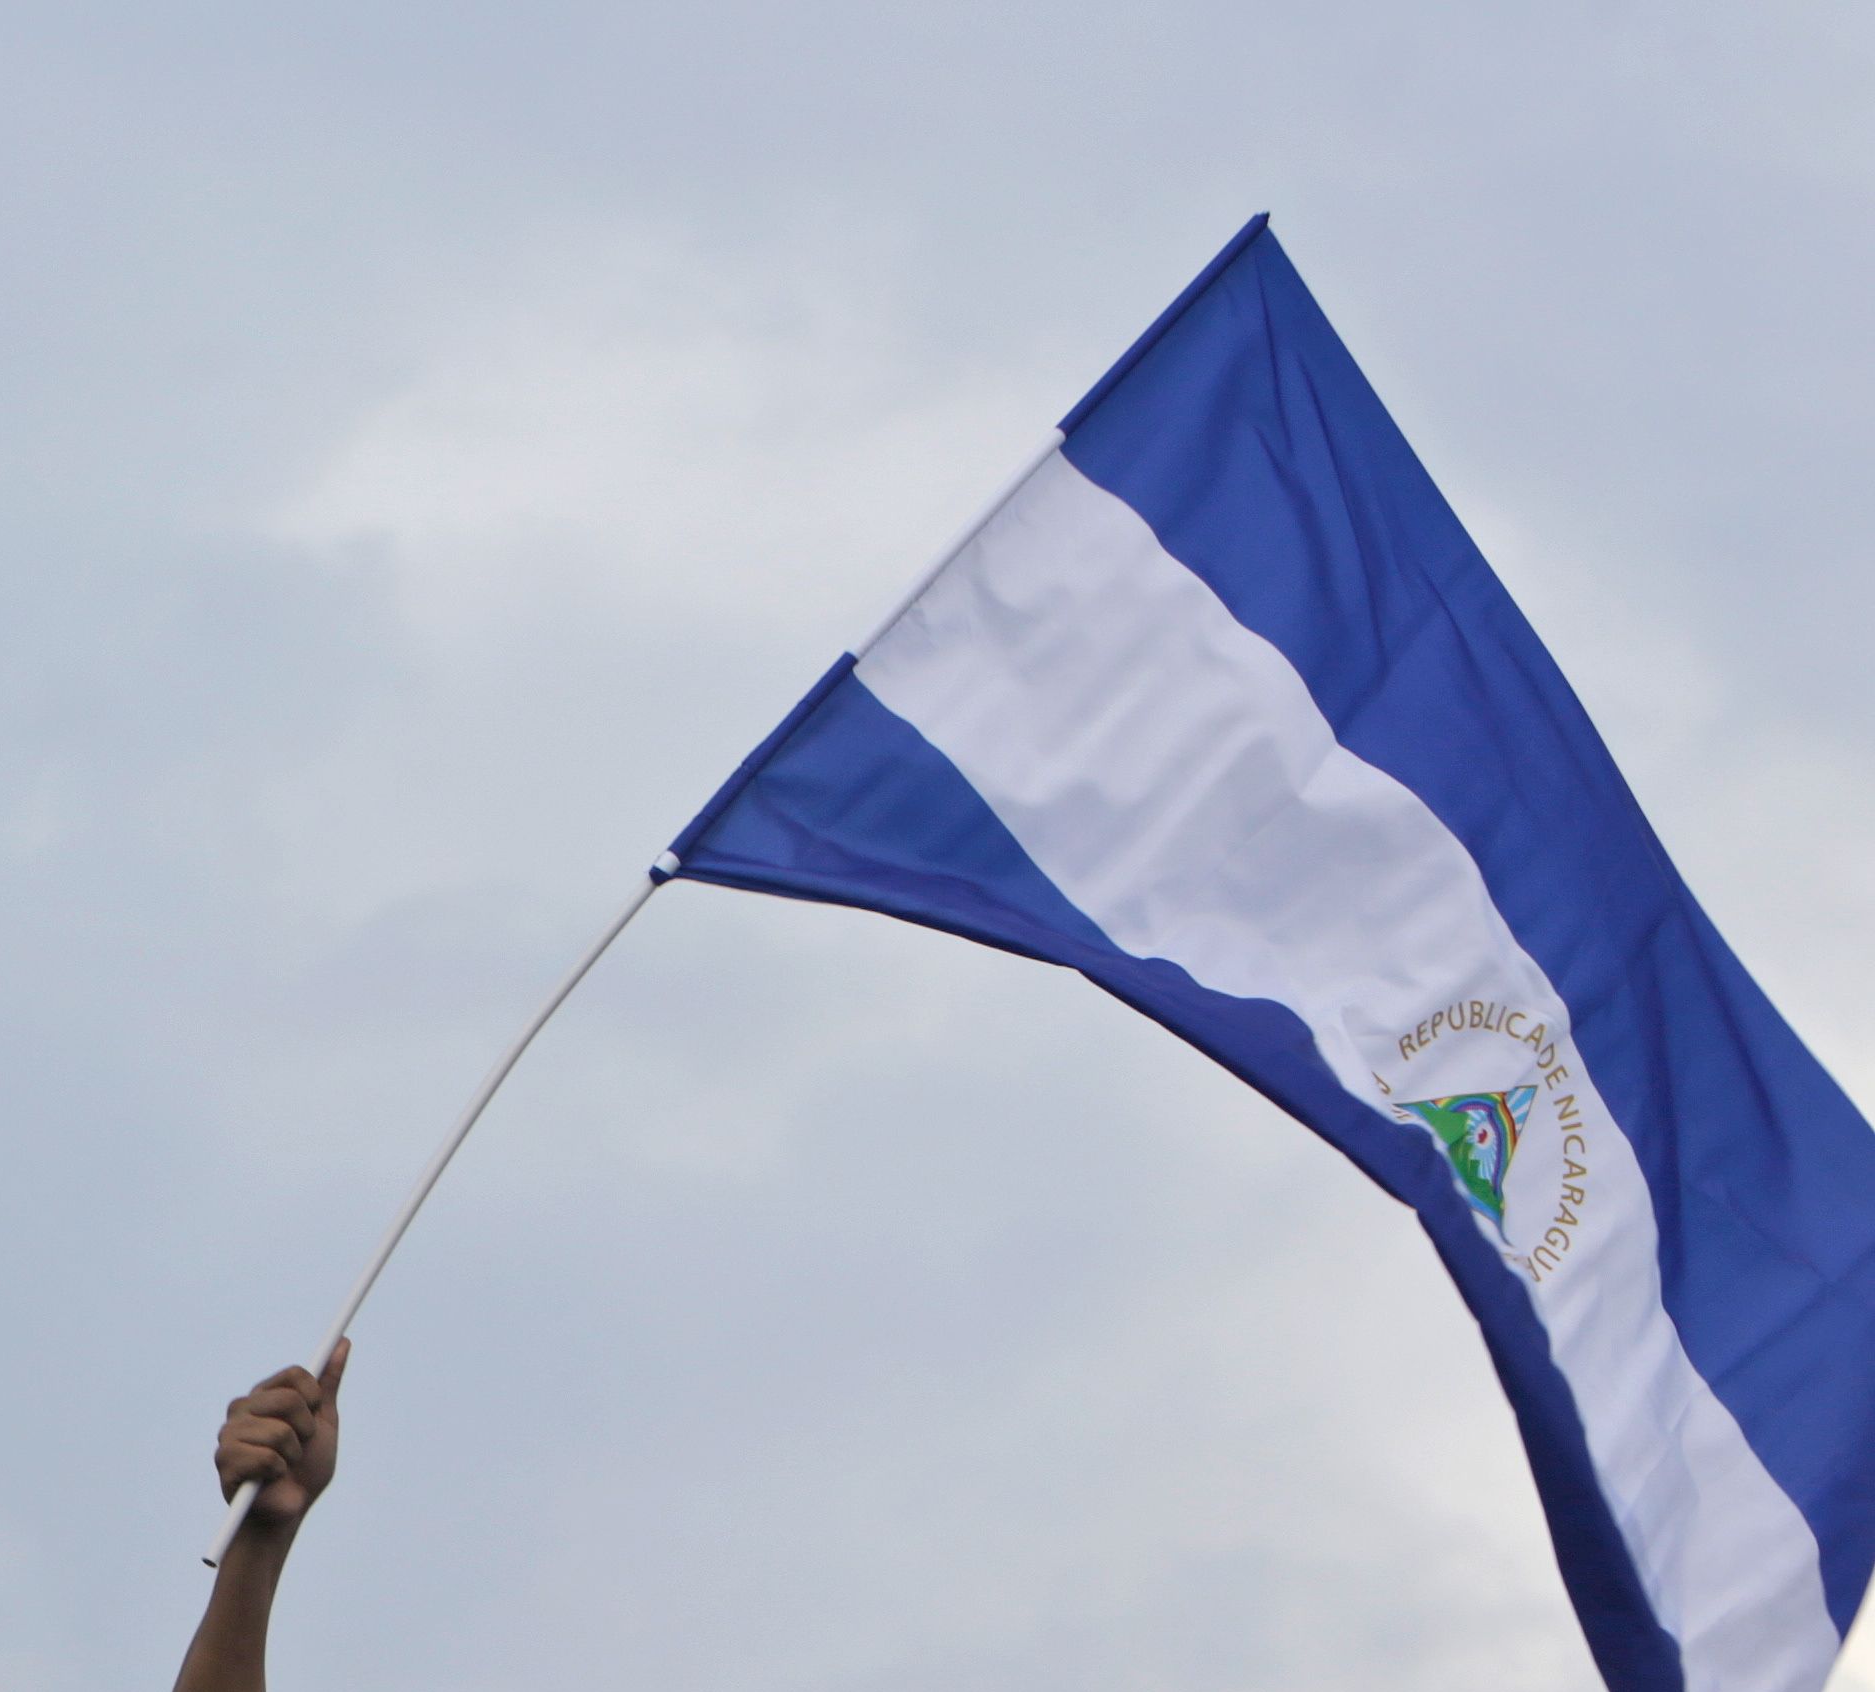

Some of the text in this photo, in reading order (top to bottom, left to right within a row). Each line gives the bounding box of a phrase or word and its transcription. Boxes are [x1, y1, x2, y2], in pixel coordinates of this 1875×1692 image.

[1398, 1000, 1588, 1282] REPUBLICA DE NICARAGUA
